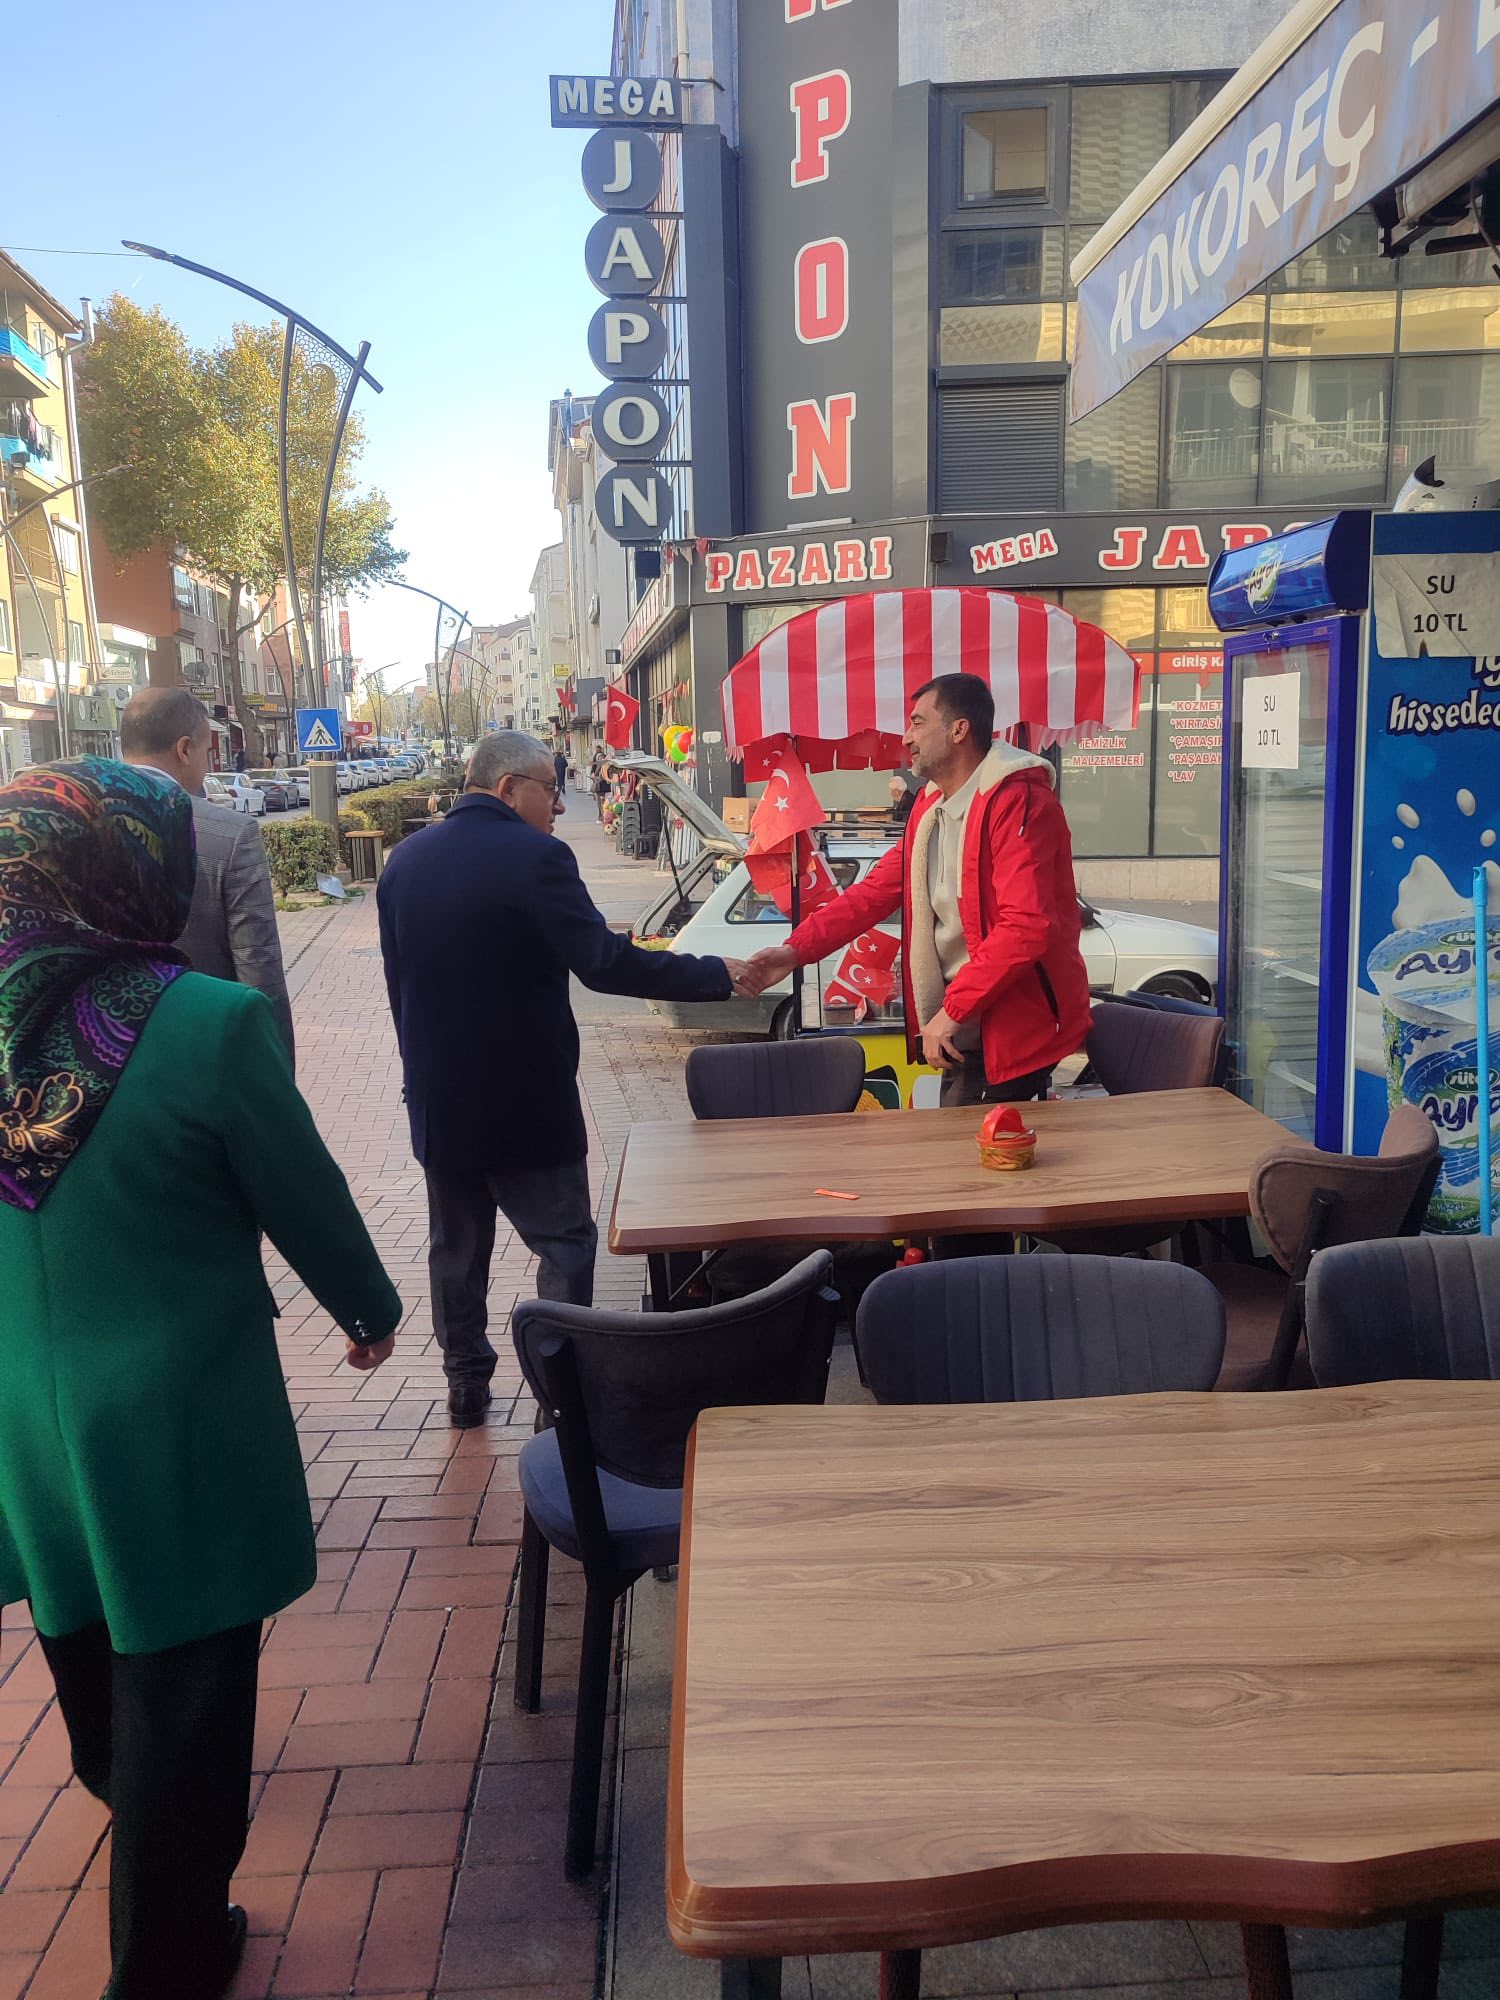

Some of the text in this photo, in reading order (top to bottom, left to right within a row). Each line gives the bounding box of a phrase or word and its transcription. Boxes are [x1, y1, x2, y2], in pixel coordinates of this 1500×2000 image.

[557, 78, 676, 117] MEGA
[1109, 21, 1385, 357] KOKOREÇ
[785, 0, 856, 500] PON
[599, 139, 660, 528] JAPON
[705, 536, 892, 593] PAZARI
[970, 528, 1058, 574] MEGA
[1425, 574, 1455, 594] SU
[1413, 612, 1468, 633] 10 TL
[1172, 654, 1207, 669] GİRİŞ
[1264, 695, 1276, 712] SU
[1258, 729, 1281, 746] 10 TL
[1072, 752, 1144, 767] MALZEMELERİ
